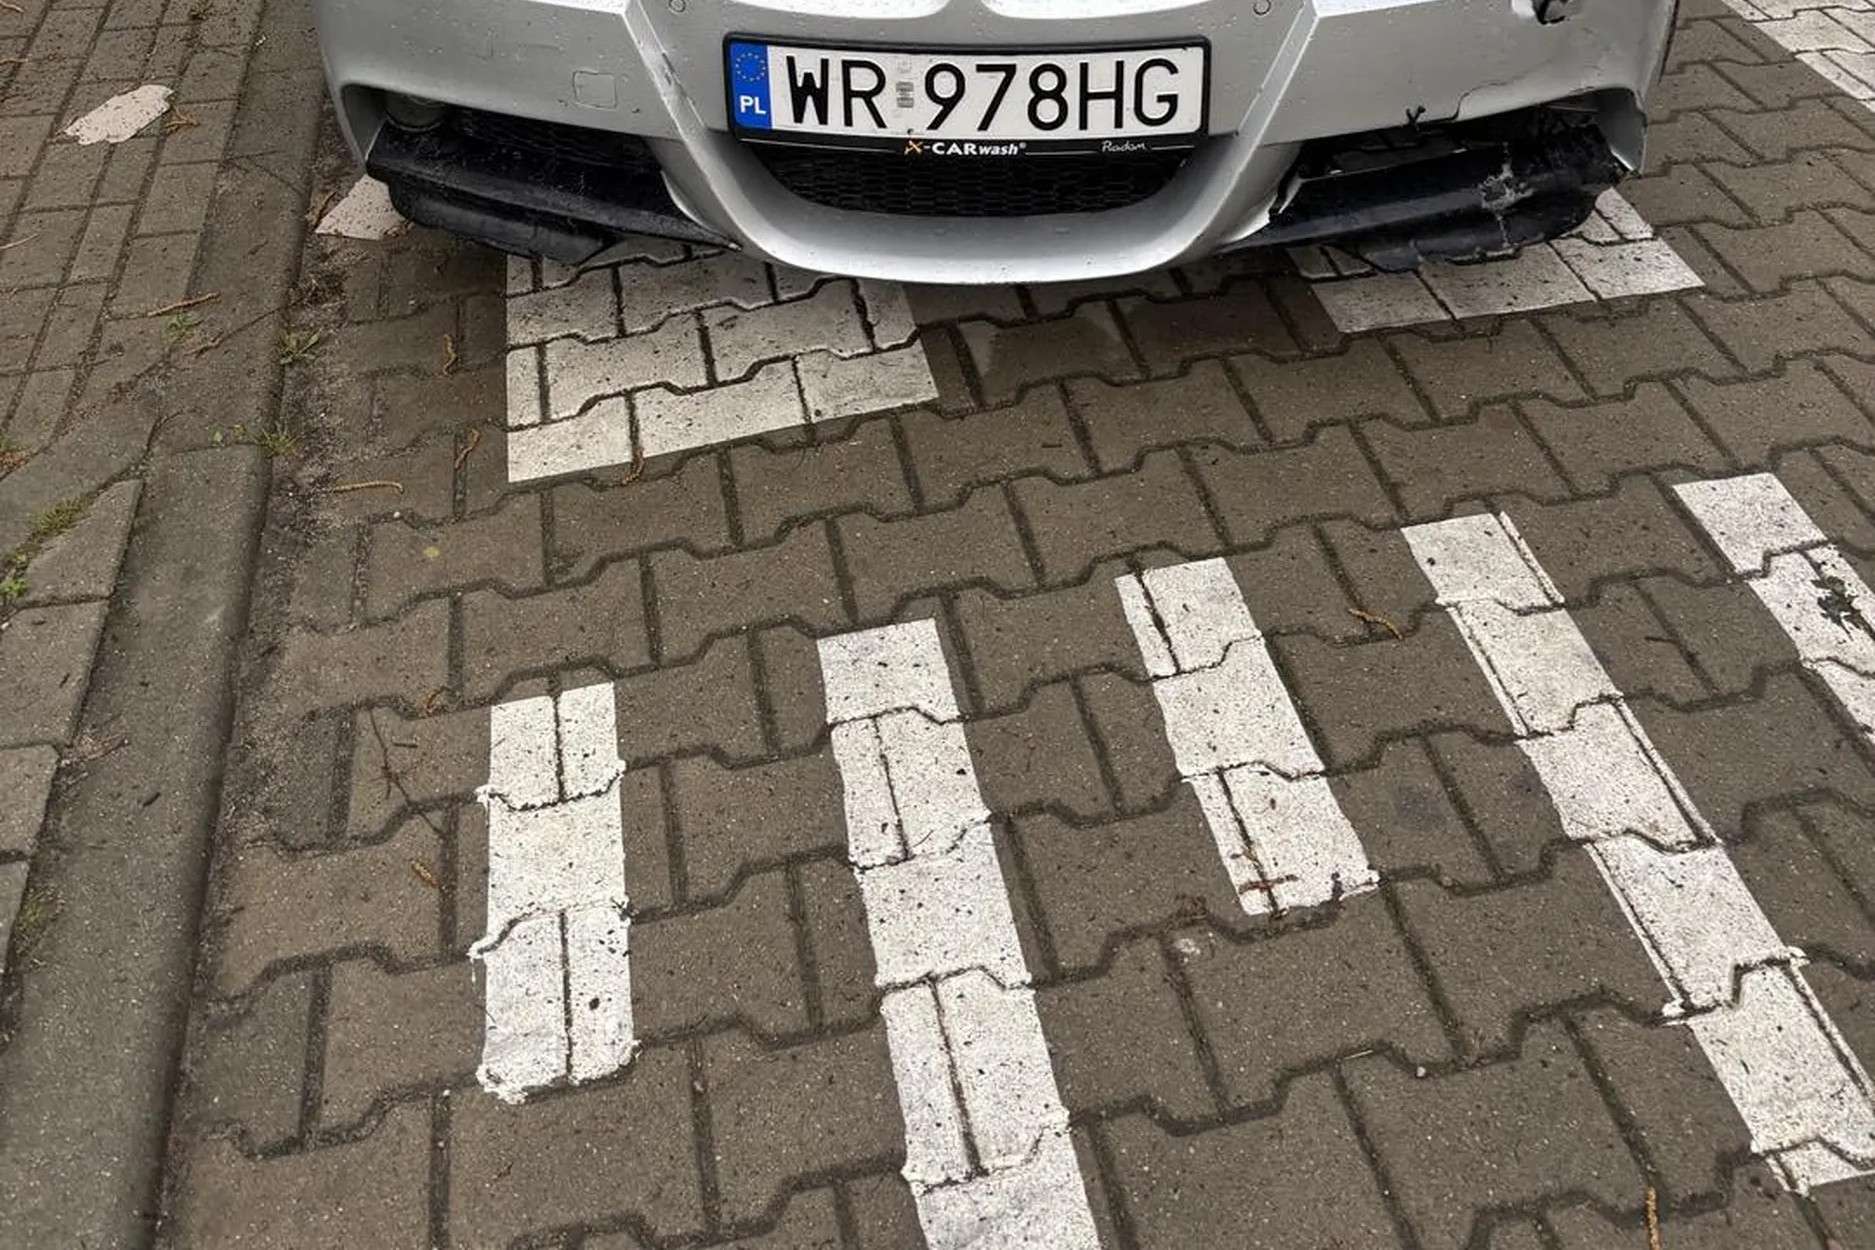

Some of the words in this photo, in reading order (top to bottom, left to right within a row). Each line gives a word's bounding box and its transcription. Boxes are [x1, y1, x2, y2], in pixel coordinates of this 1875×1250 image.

[740, 94, 767, 116] PL
[785, 55, 888, 129] WR
[924, 58, 1180, 132] 978HG
